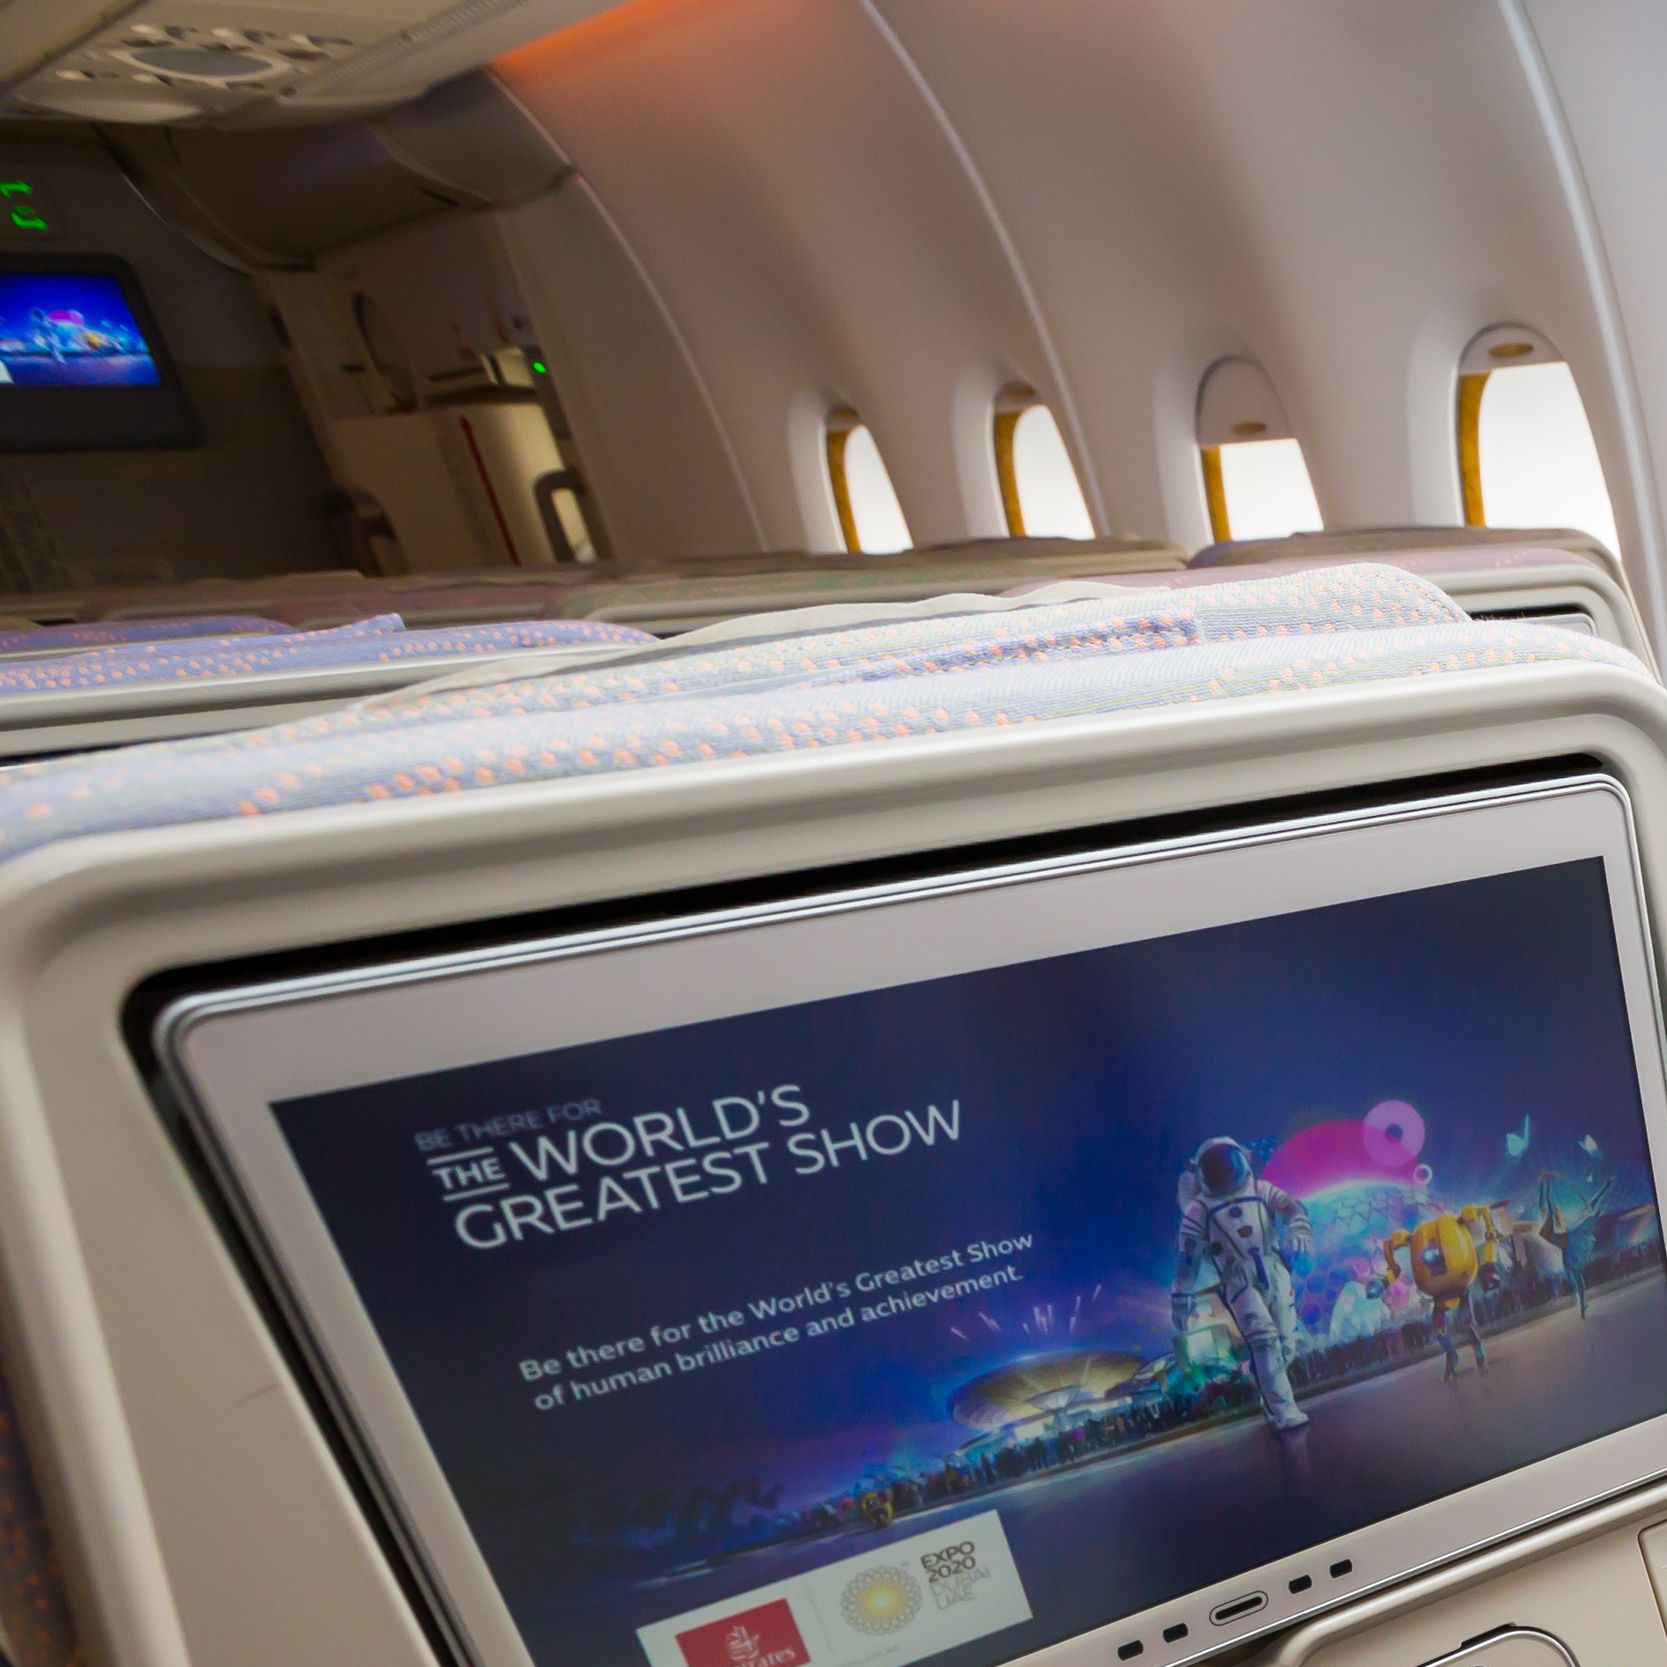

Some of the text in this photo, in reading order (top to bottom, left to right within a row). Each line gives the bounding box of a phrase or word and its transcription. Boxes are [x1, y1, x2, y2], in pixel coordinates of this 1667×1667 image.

[414, 1098, 602, 1152] BE THERE FOR
[432, 1083, 810, 1190] THE WORLD'S
[454, 1099, 960, 1249] GREATEST SHOW
[519, 1233, 1034, 1382] Be there for the World's Greatest Show
[533, 1264, 1024, 1410] of human brilliance and achievement.
[920, 1541, 975, 1569] EXPO
[926, 1555, 976, 1583] 2020
